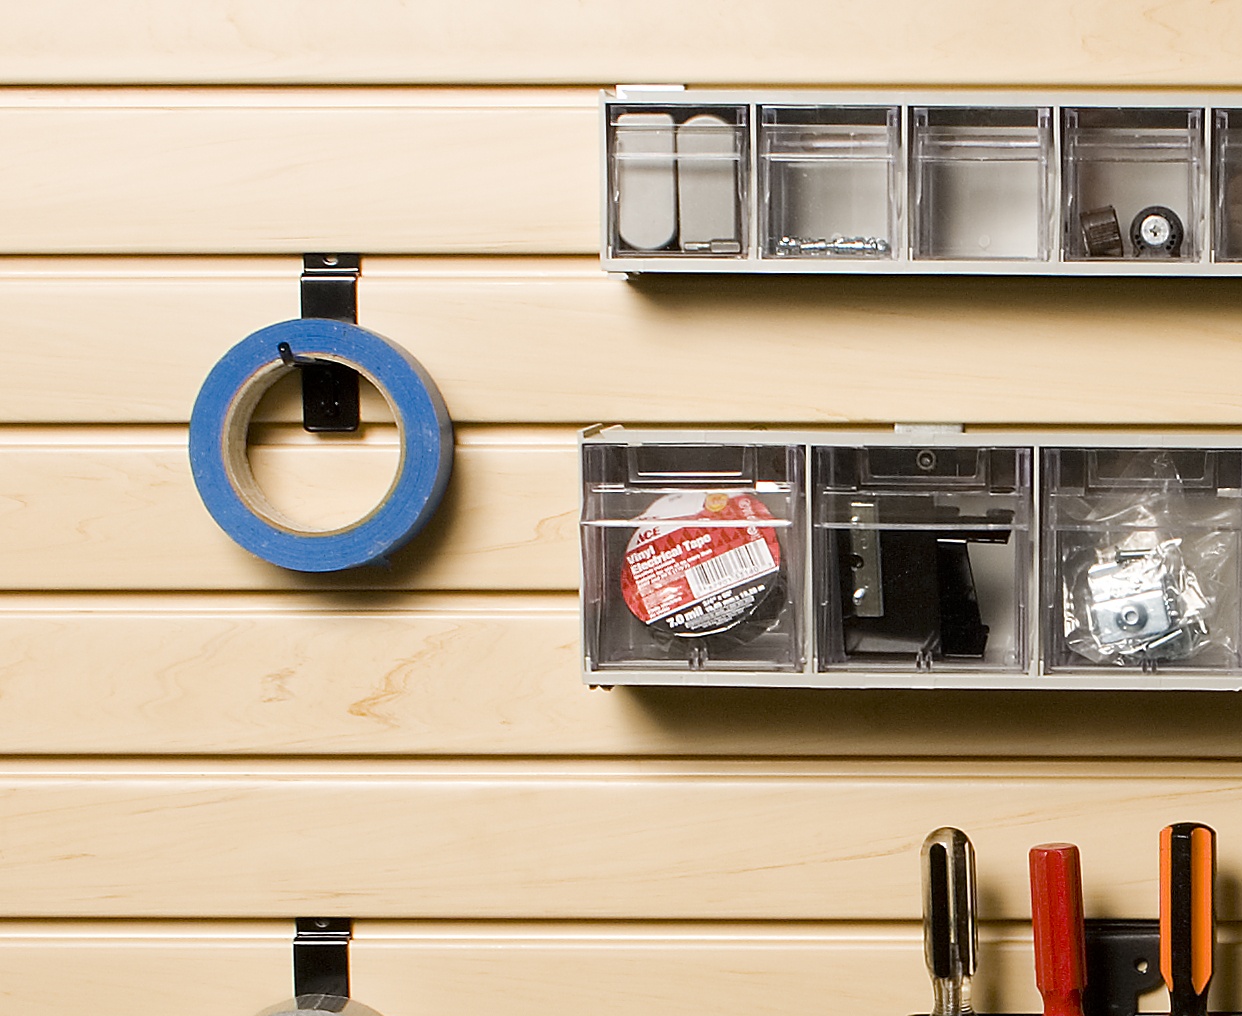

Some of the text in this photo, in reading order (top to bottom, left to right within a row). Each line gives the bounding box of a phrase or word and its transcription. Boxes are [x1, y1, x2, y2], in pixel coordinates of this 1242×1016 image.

[636, 526, 661, 544] ACE
[626, 545, 656, 565] Vinyl
[630, 544, 683, 575] Electrical
[682, 533, 712, 552] Tape
[684, 605, 704, 622] mil
